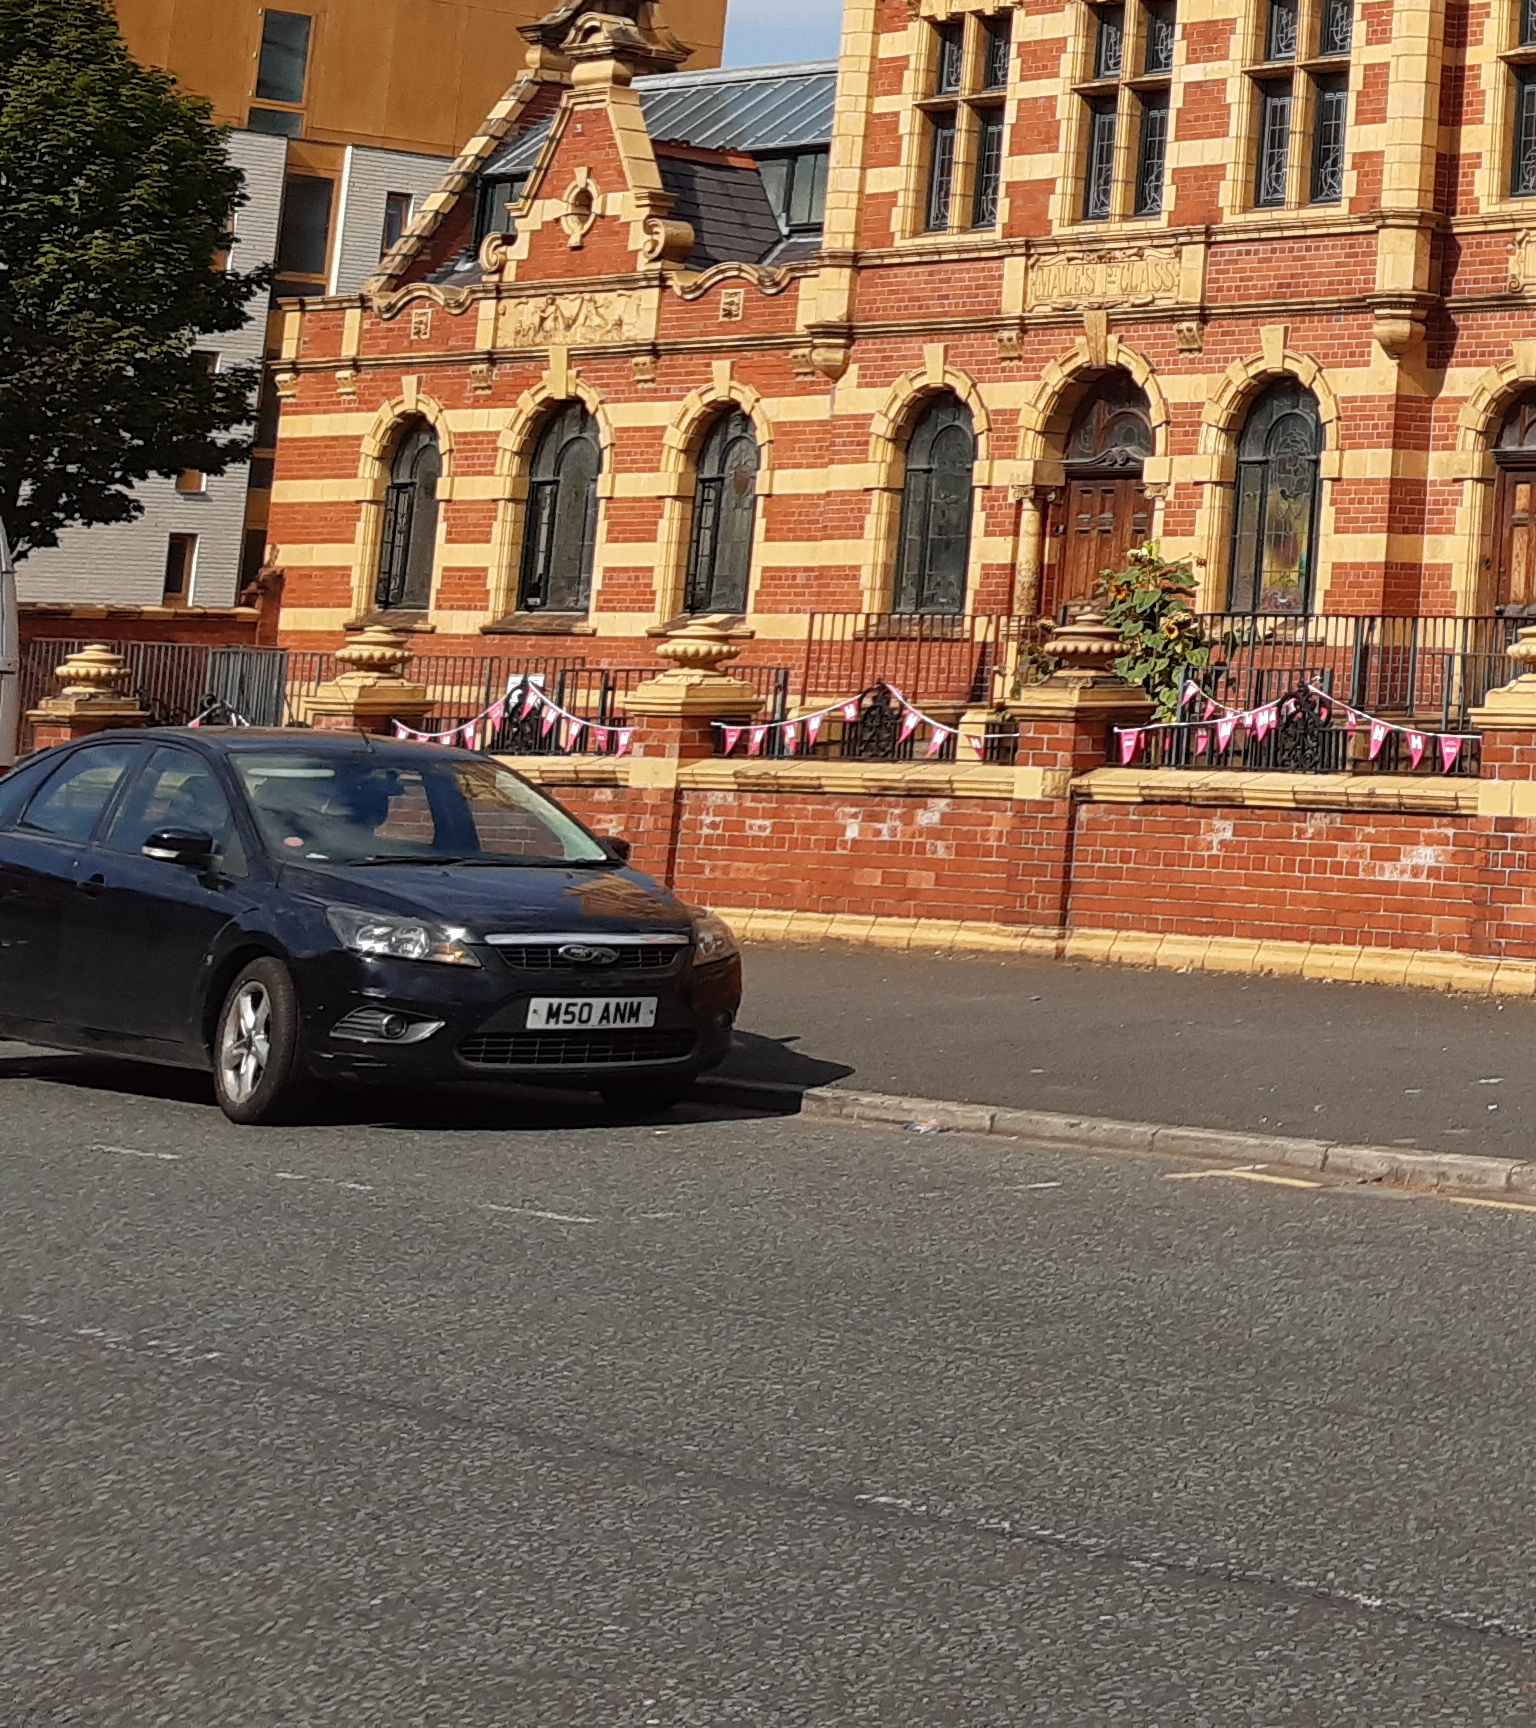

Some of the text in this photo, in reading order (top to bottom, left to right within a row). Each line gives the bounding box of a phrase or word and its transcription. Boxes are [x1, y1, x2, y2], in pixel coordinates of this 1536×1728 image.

[1035, 265, 1096, 297] MALES
[1121, 262, 1176, 293] CLASS
[1373, 725, 1384, 742] H
[1411, 735, 1422, 750] H
[545, 1001, 642, 1025] M50 ANM
